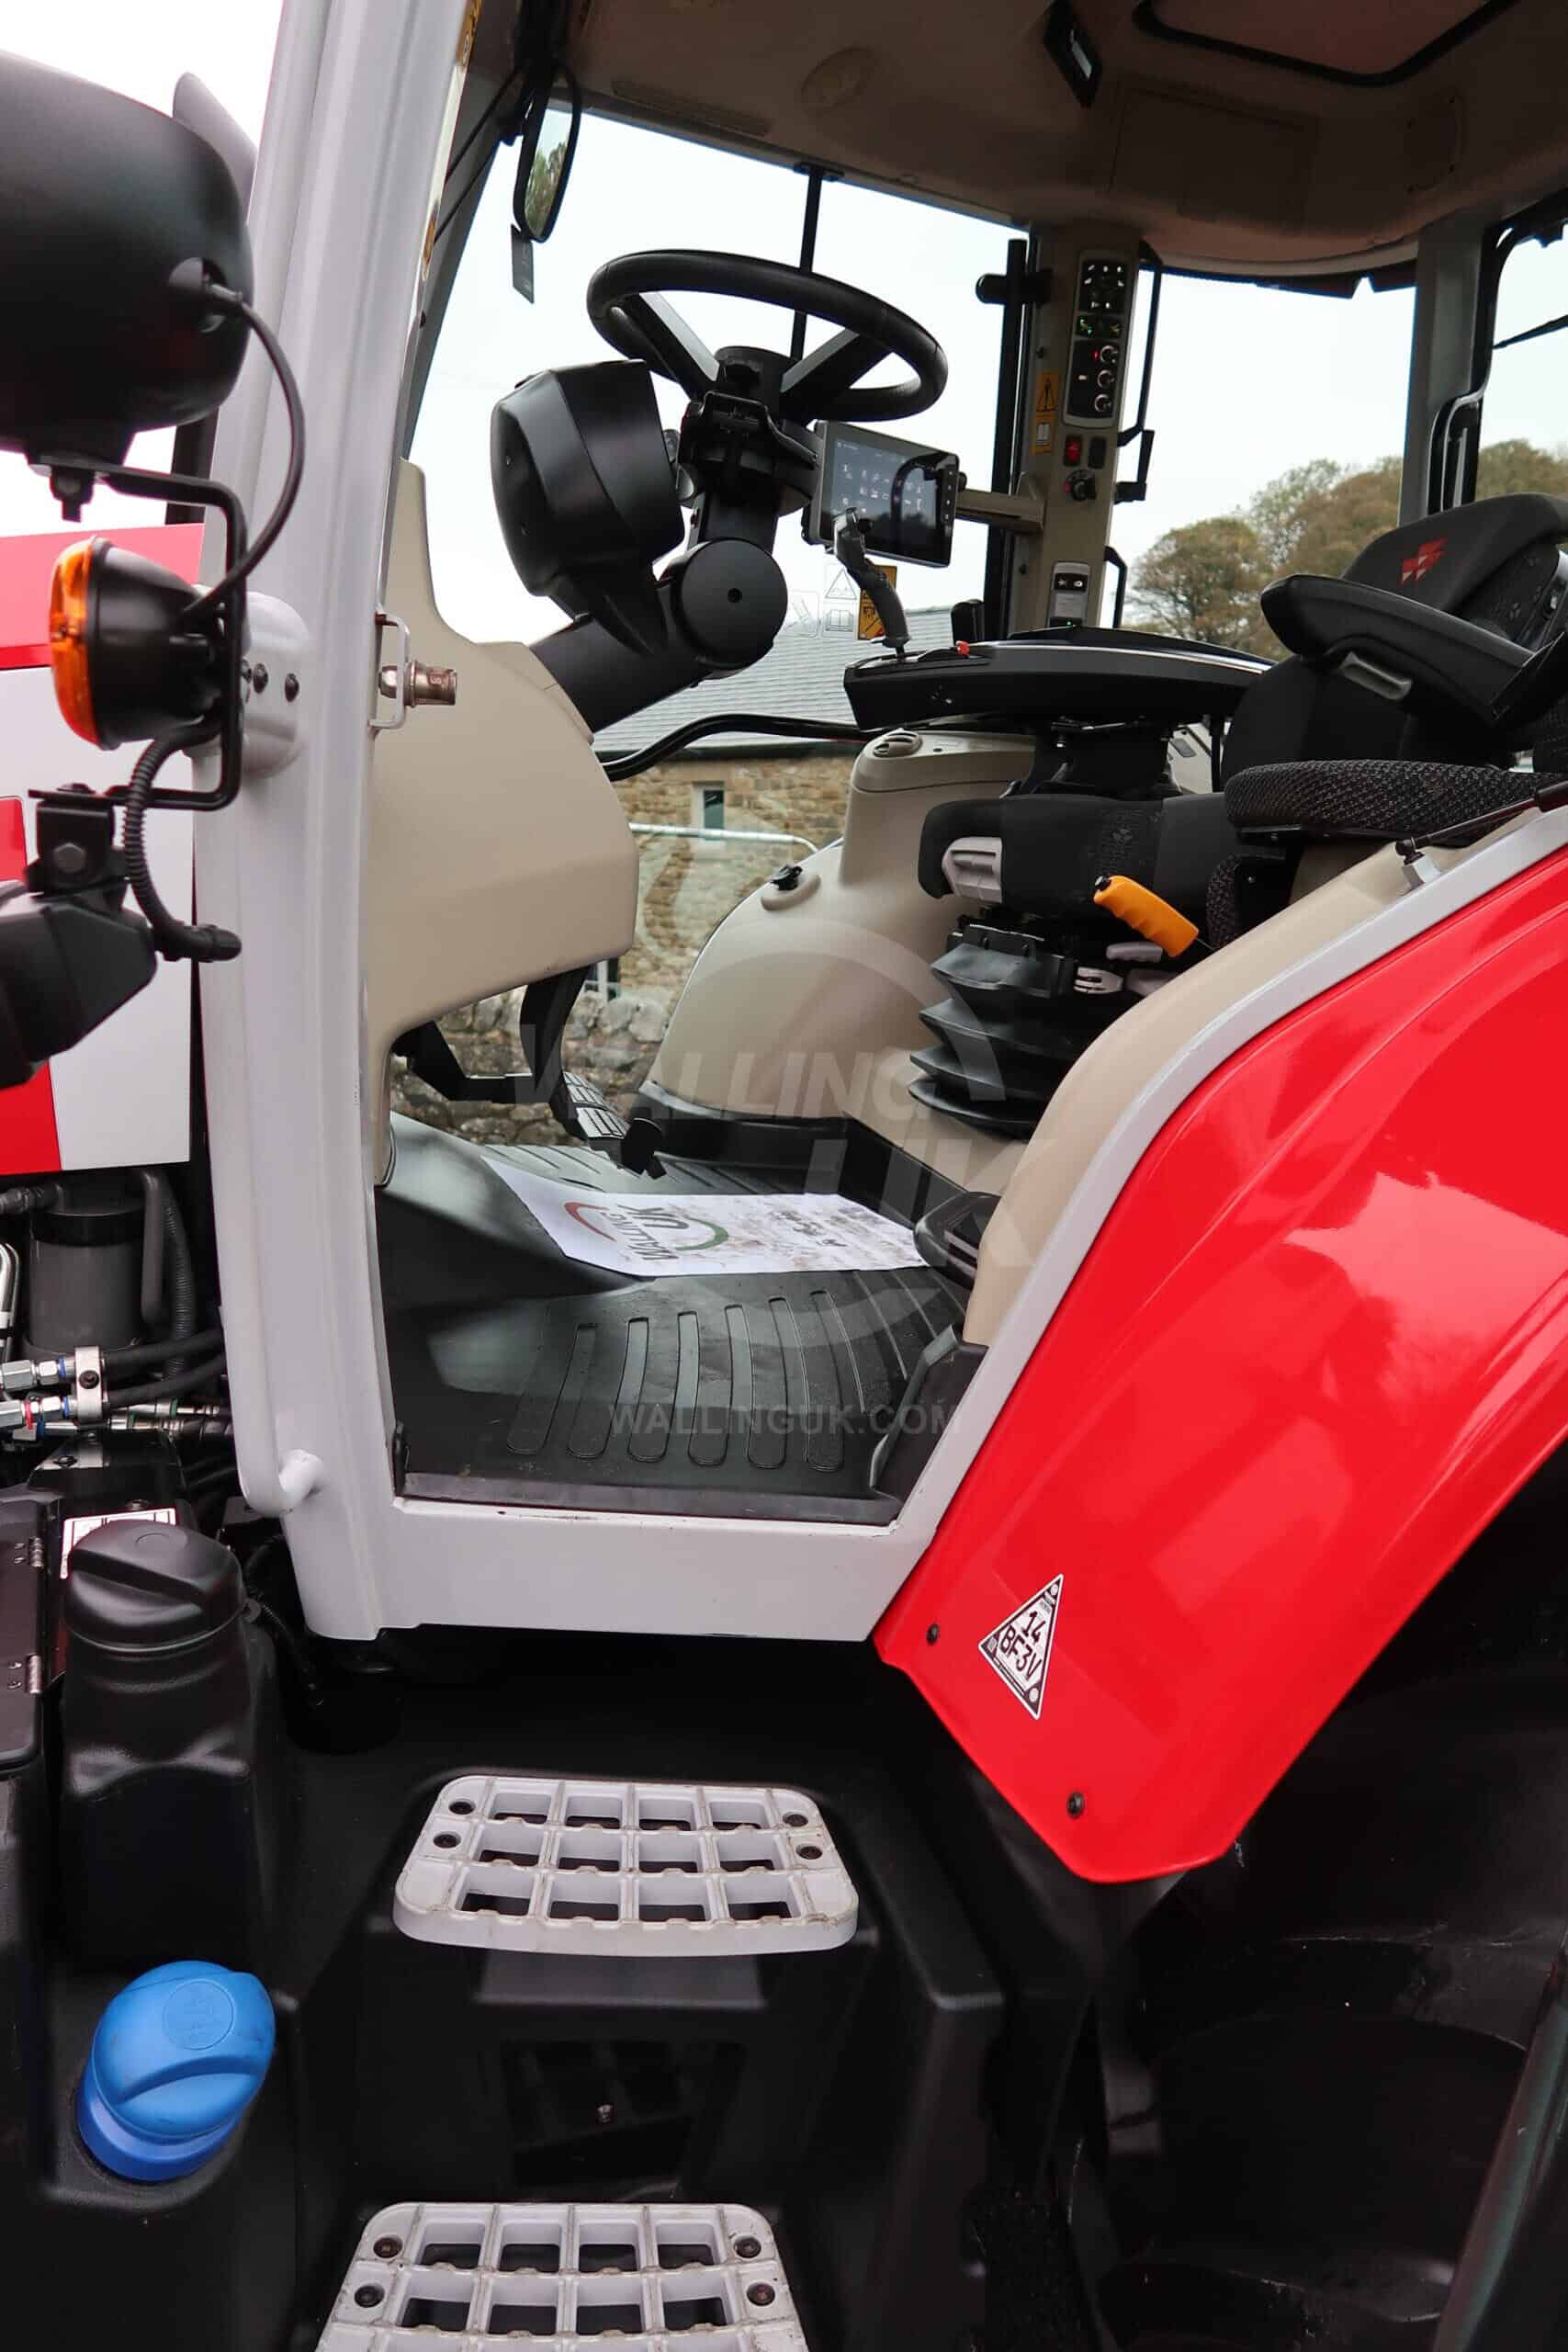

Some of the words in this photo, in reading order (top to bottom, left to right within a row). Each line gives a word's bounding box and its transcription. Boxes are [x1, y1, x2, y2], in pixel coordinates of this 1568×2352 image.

[602, 1211, 679, 1261] WALLING
[615, 1204, 690, 1229] UK
[1021, 1611, 1046, 1645] 14
[999, 1624, 1043, 1681] BF3V
